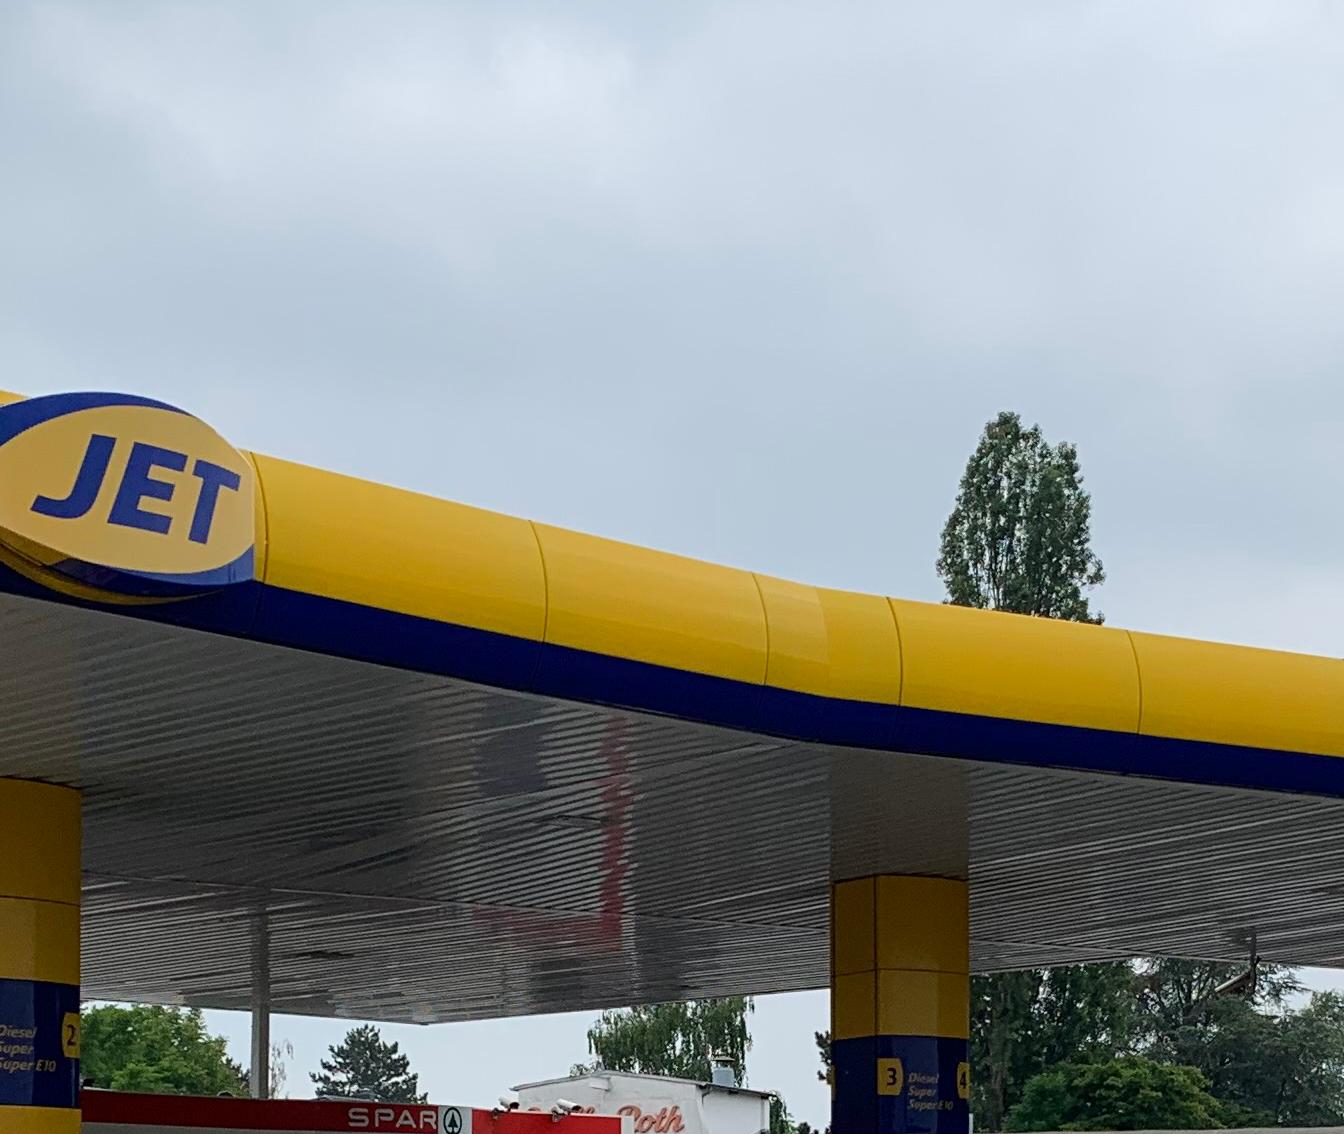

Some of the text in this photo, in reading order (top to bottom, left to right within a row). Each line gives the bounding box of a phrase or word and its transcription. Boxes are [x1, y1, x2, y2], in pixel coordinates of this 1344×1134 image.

[30, 433, 241, 545] JET
[66, 1024, 76, 1046] 2
[36, 1059, 56, 1072] E10
[886, 1067, 897, 1087] 3
[908, 1072, 940, 1084] Diesel
[959, 1071, 967, 1089] 4
[907, 1085, 937, 1099] Super
[347, 1107, 438, 1130] SPAR
